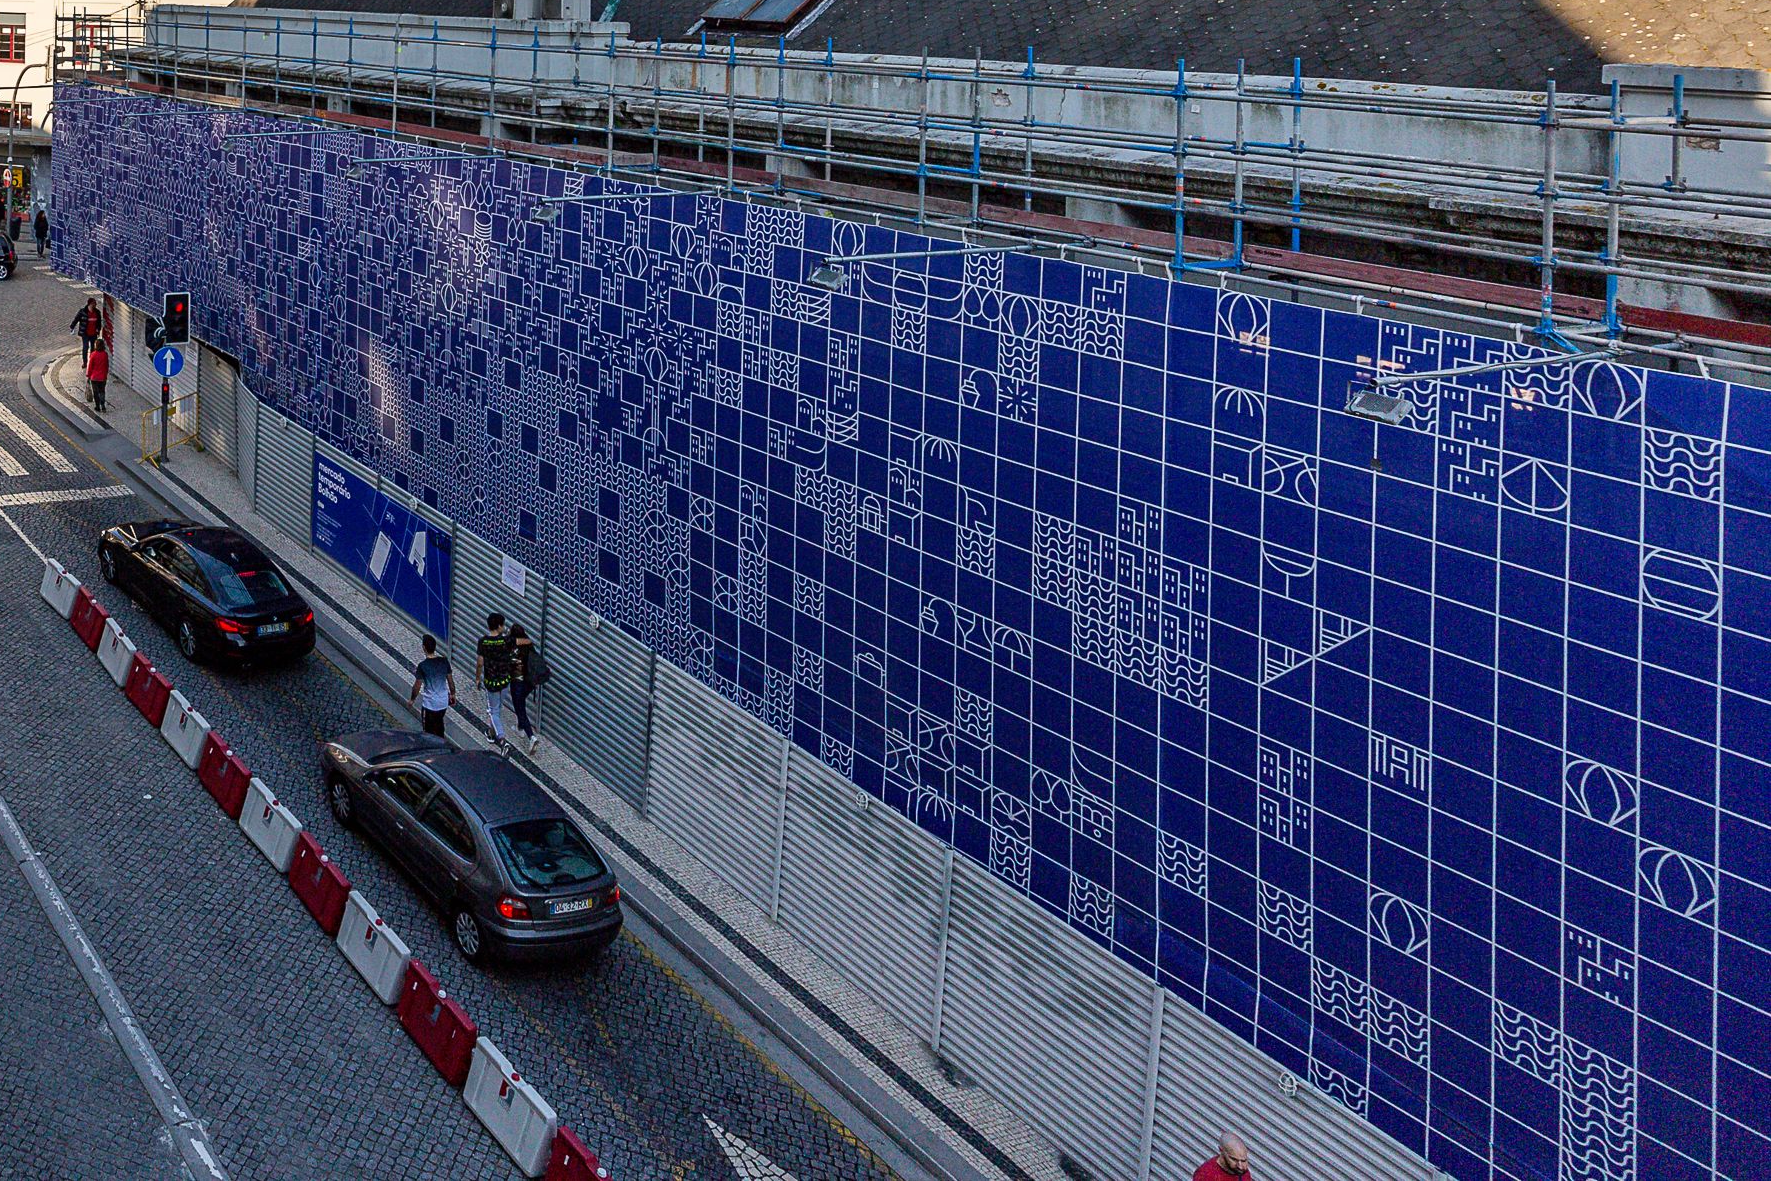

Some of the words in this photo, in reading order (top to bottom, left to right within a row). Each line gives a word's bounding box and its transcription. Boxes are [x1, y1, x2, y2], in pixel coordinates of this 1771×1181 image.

[318, 462, 346, 484] mercado
[317, 482, 338, 504] Bolhão
[318, 471, 351, 500] temporário
